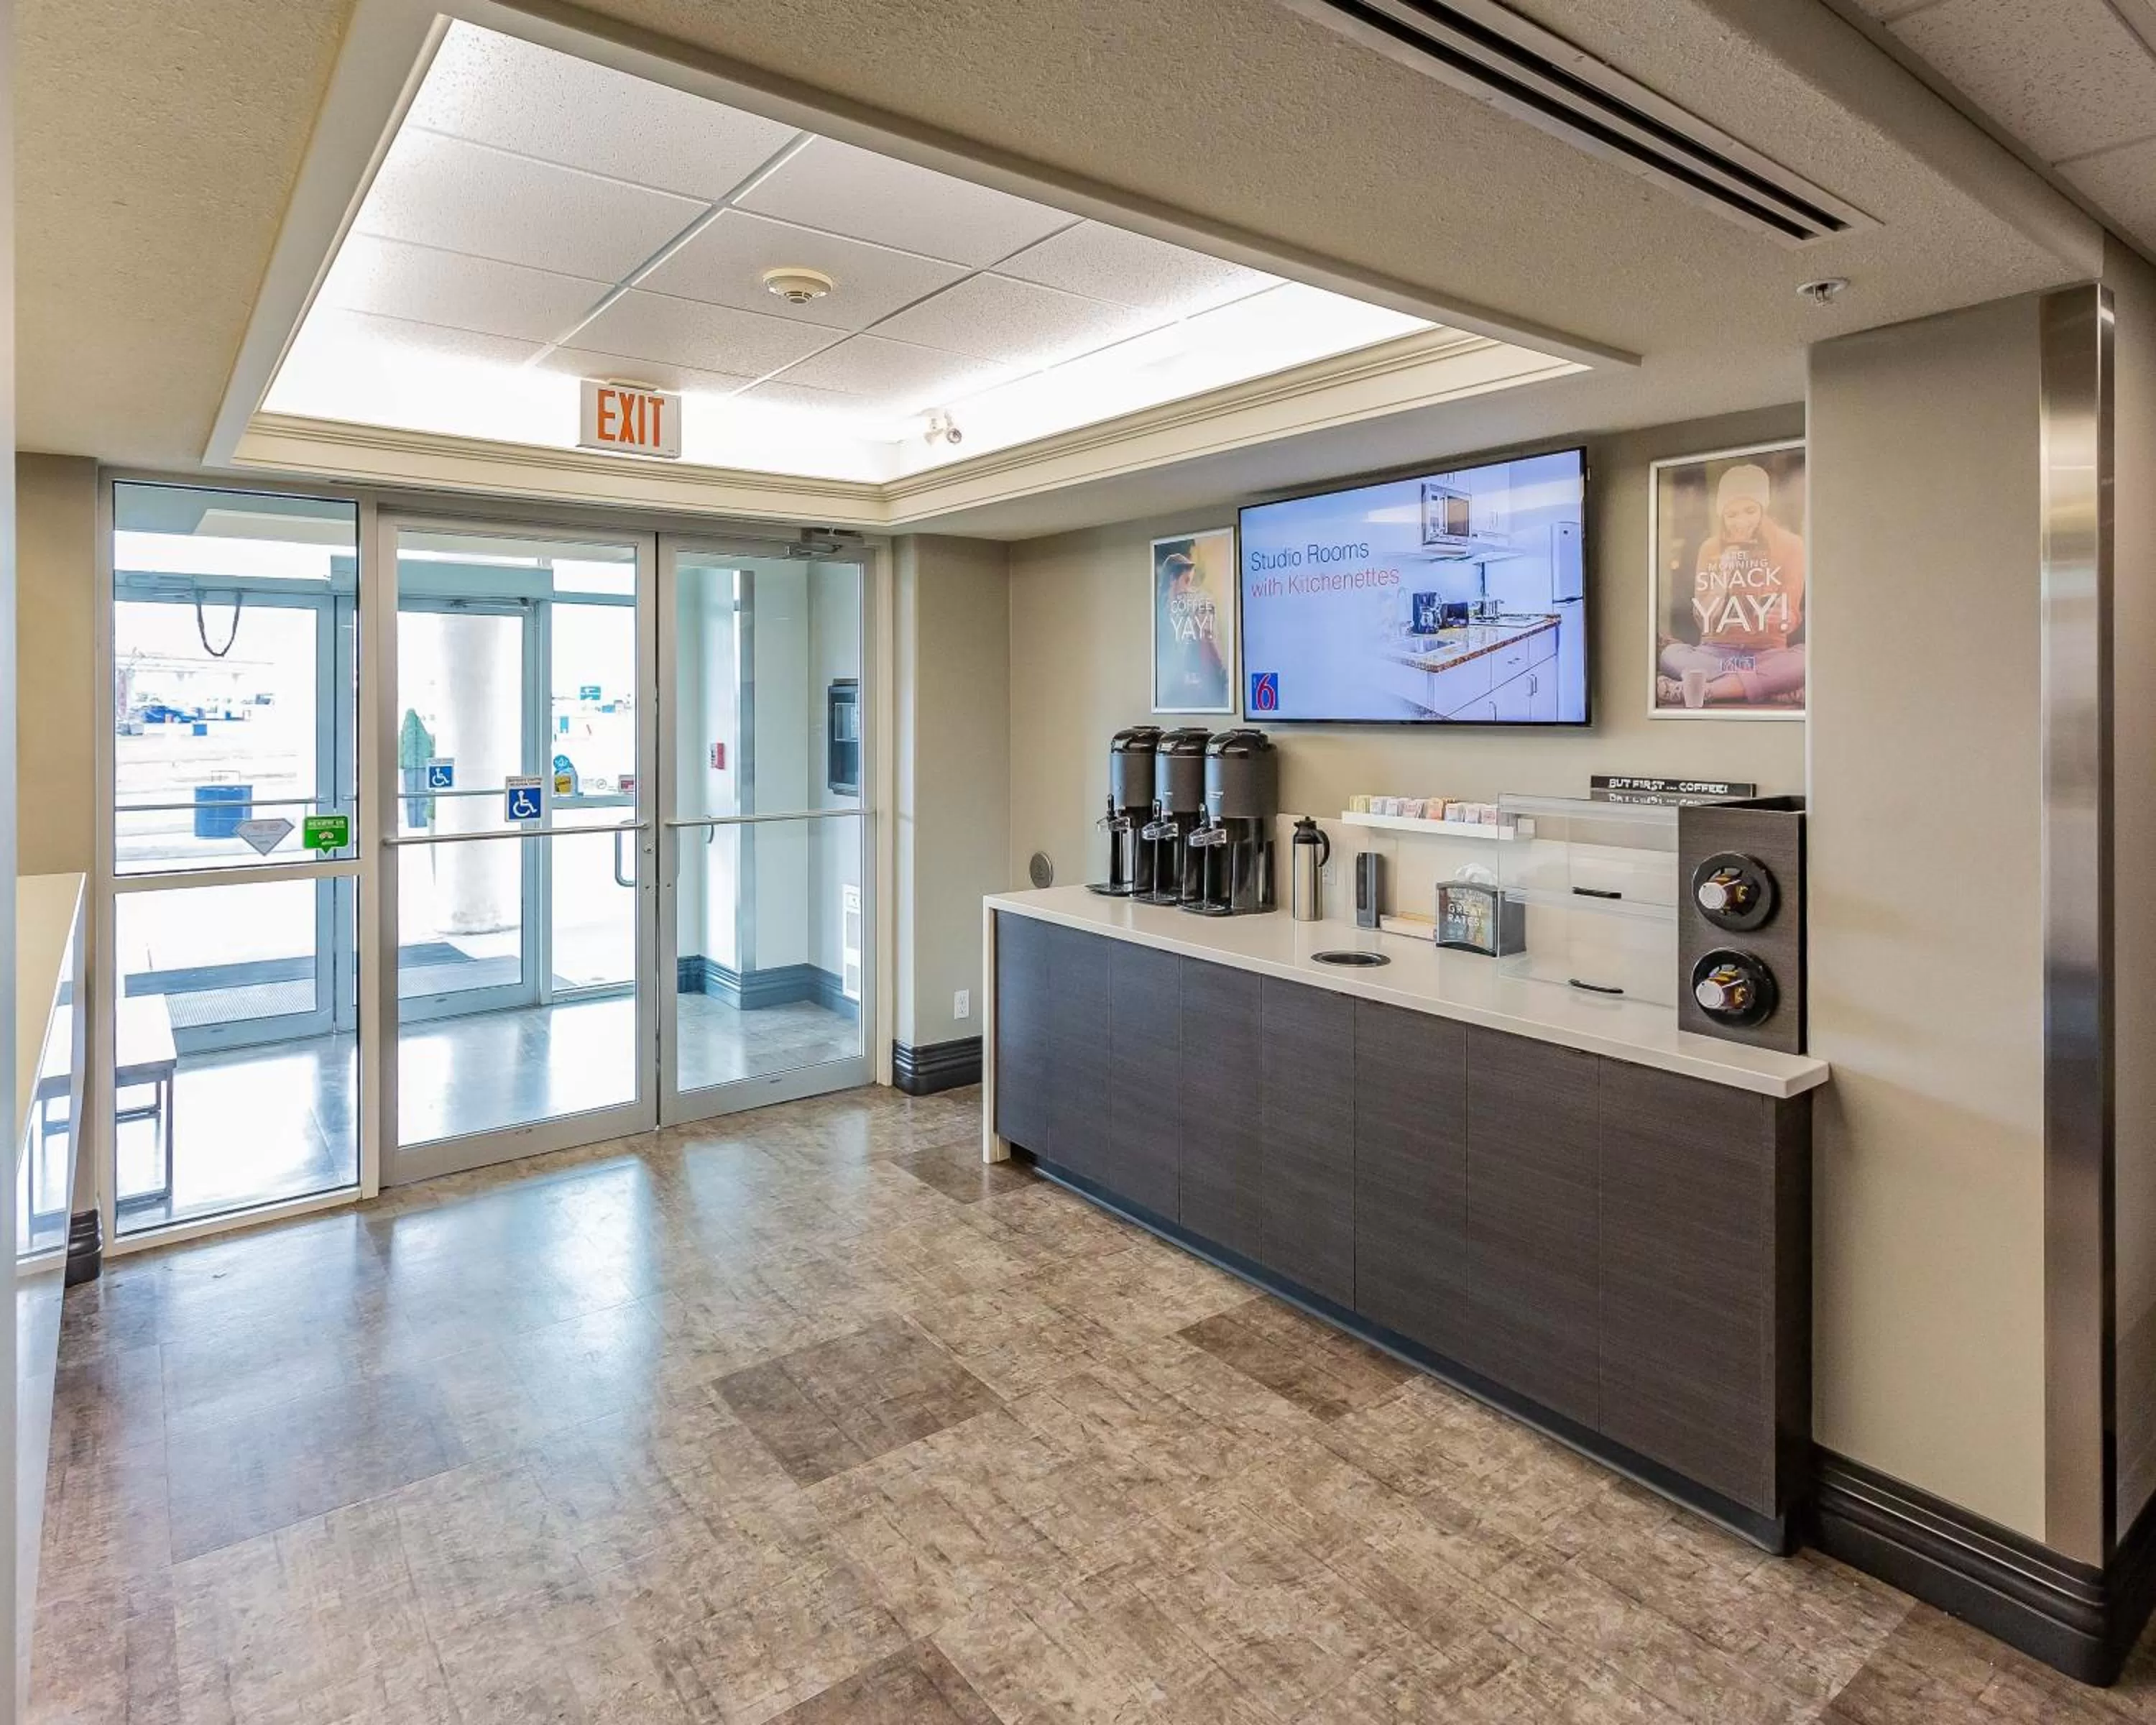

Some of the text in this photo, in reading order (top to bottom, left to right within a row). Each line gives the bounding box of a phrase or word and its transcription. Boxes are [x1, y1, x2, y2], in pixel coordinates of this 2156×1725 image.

[598, 389, 665, 447] EXIT
[1250, 542, 1369, 571] Studio Rooms
[1251, 567, 1400, 598] with Kitchenettes
[1696, 566, 1782, 592] SNACK
[1171, 597, 1212, 613] COFFEE
[1691, 592, 1788, 633] YAY!
[1170, 614, 1213, 641] YAY!
[1256, 673, 1276, 711] 6
[1609, 778, 1631, 788] BUT
[1632, 780, 1665, 791] FIRST
